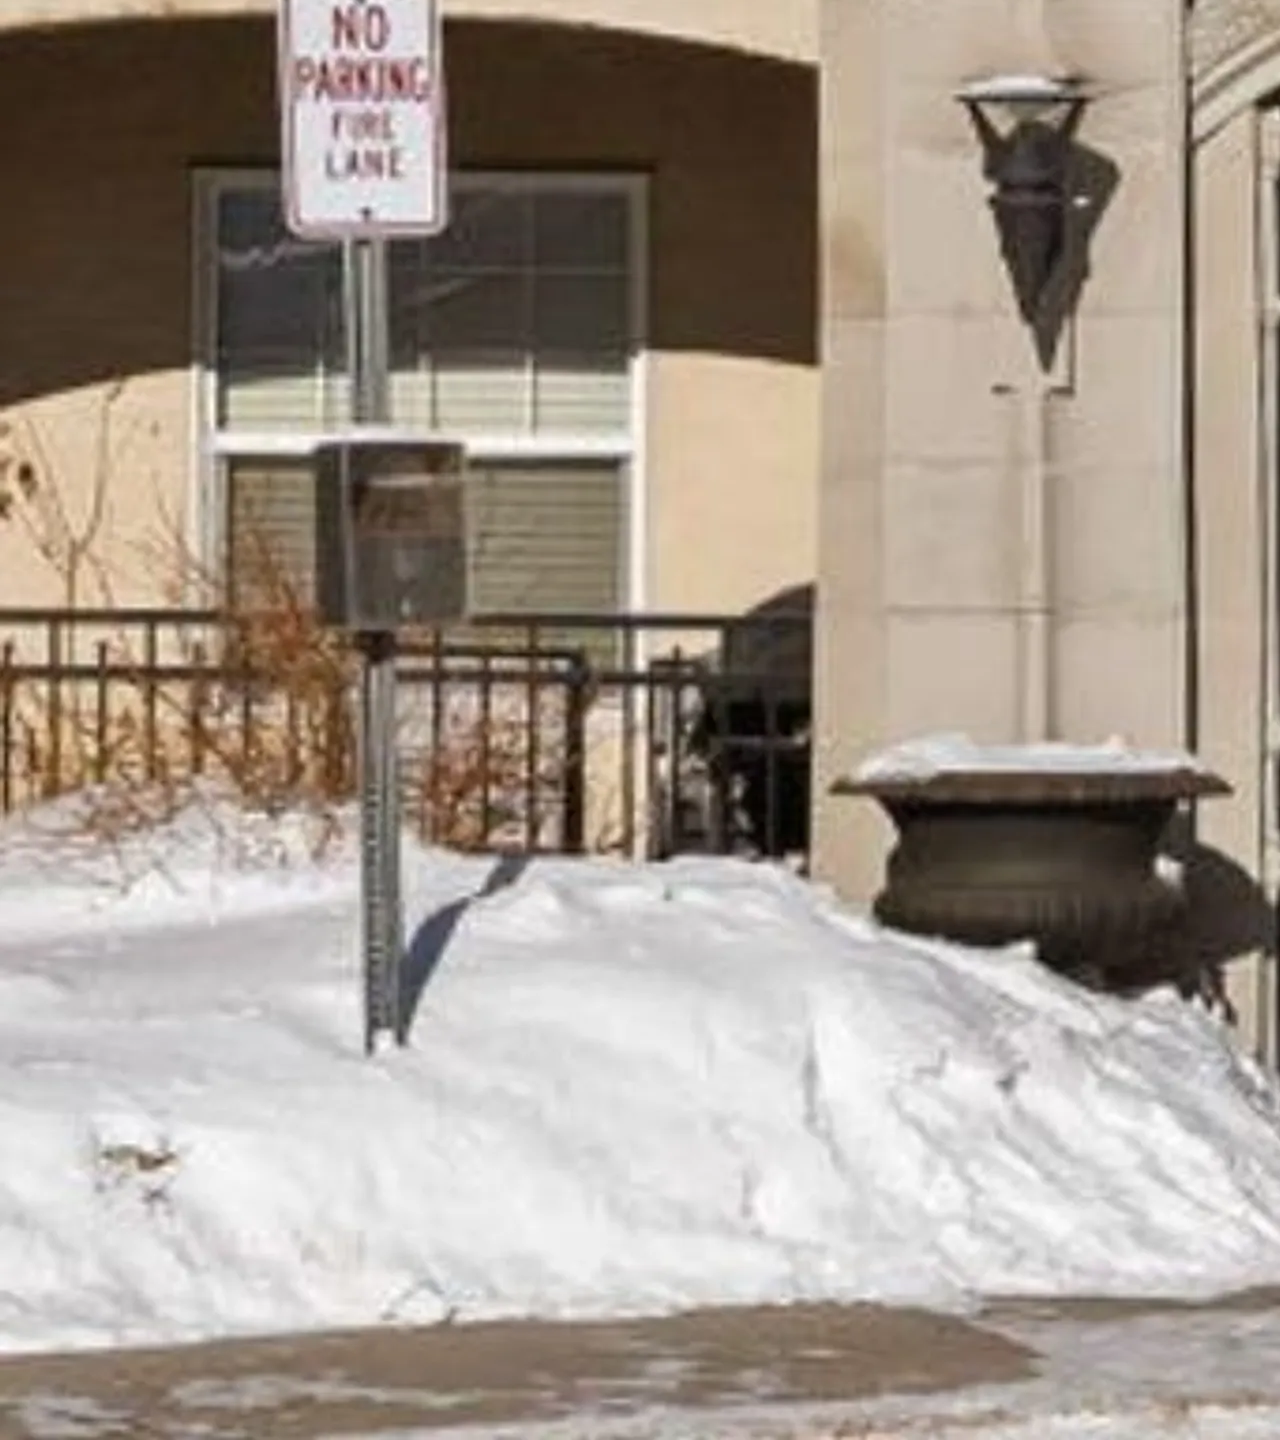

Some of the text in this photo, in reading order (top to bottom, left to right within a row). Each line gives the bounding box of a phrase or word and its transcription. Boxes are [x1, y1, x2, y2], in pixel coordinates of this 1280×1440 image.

[332, 4, 390, 51] NO
[293, 57, 432, 103] PARKING
[324, 147, 404, 180] LANE
